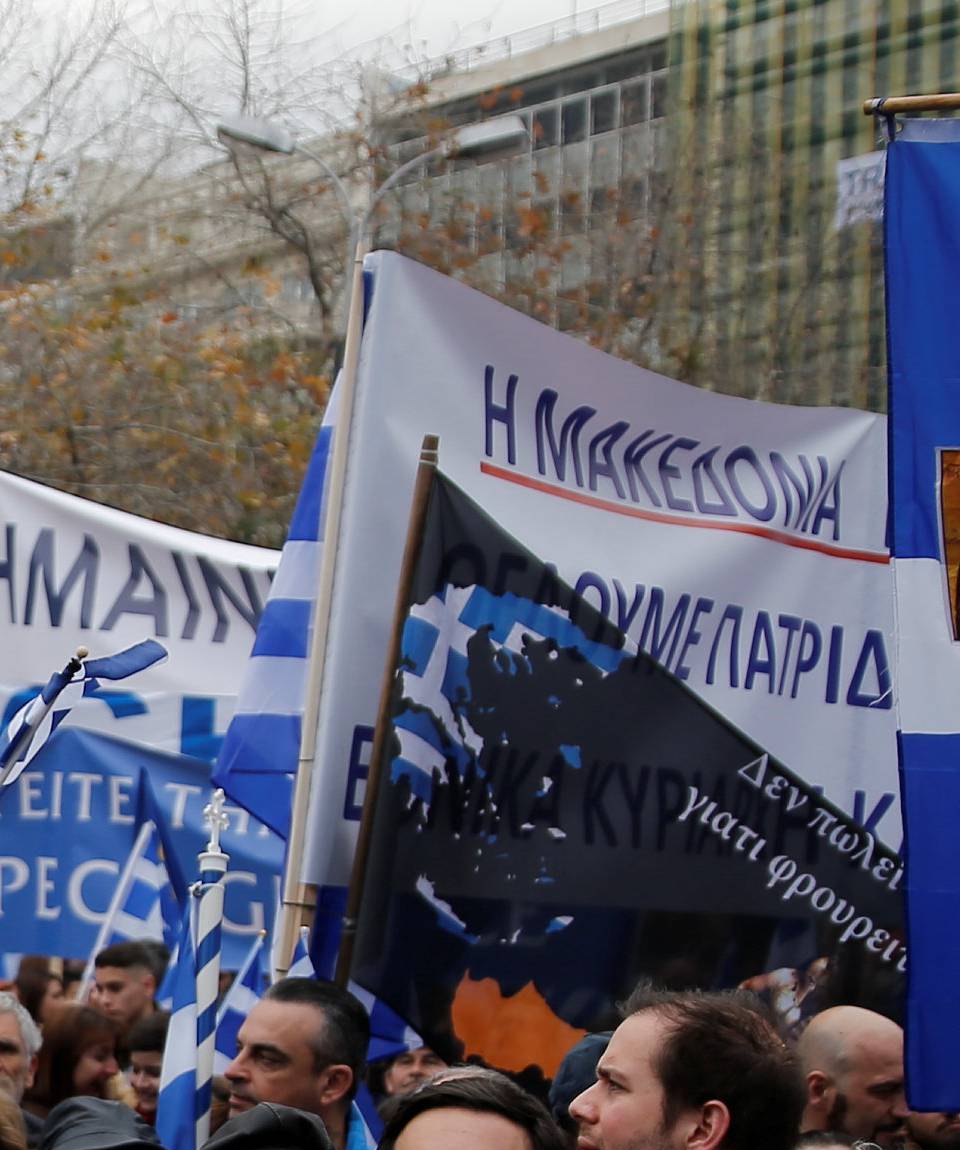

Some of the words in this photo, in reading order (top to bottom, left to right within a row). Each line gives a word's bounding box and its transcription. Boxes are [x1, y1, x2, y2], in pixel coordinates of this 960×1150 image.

[484, 364, 519, 466] Η
[534, 387, 846, 542] ΜΑΚΕΔΟΝΙΑ
[738, 752, 808, 812] Δεν
[676, 785, 767, 862] γιατι
